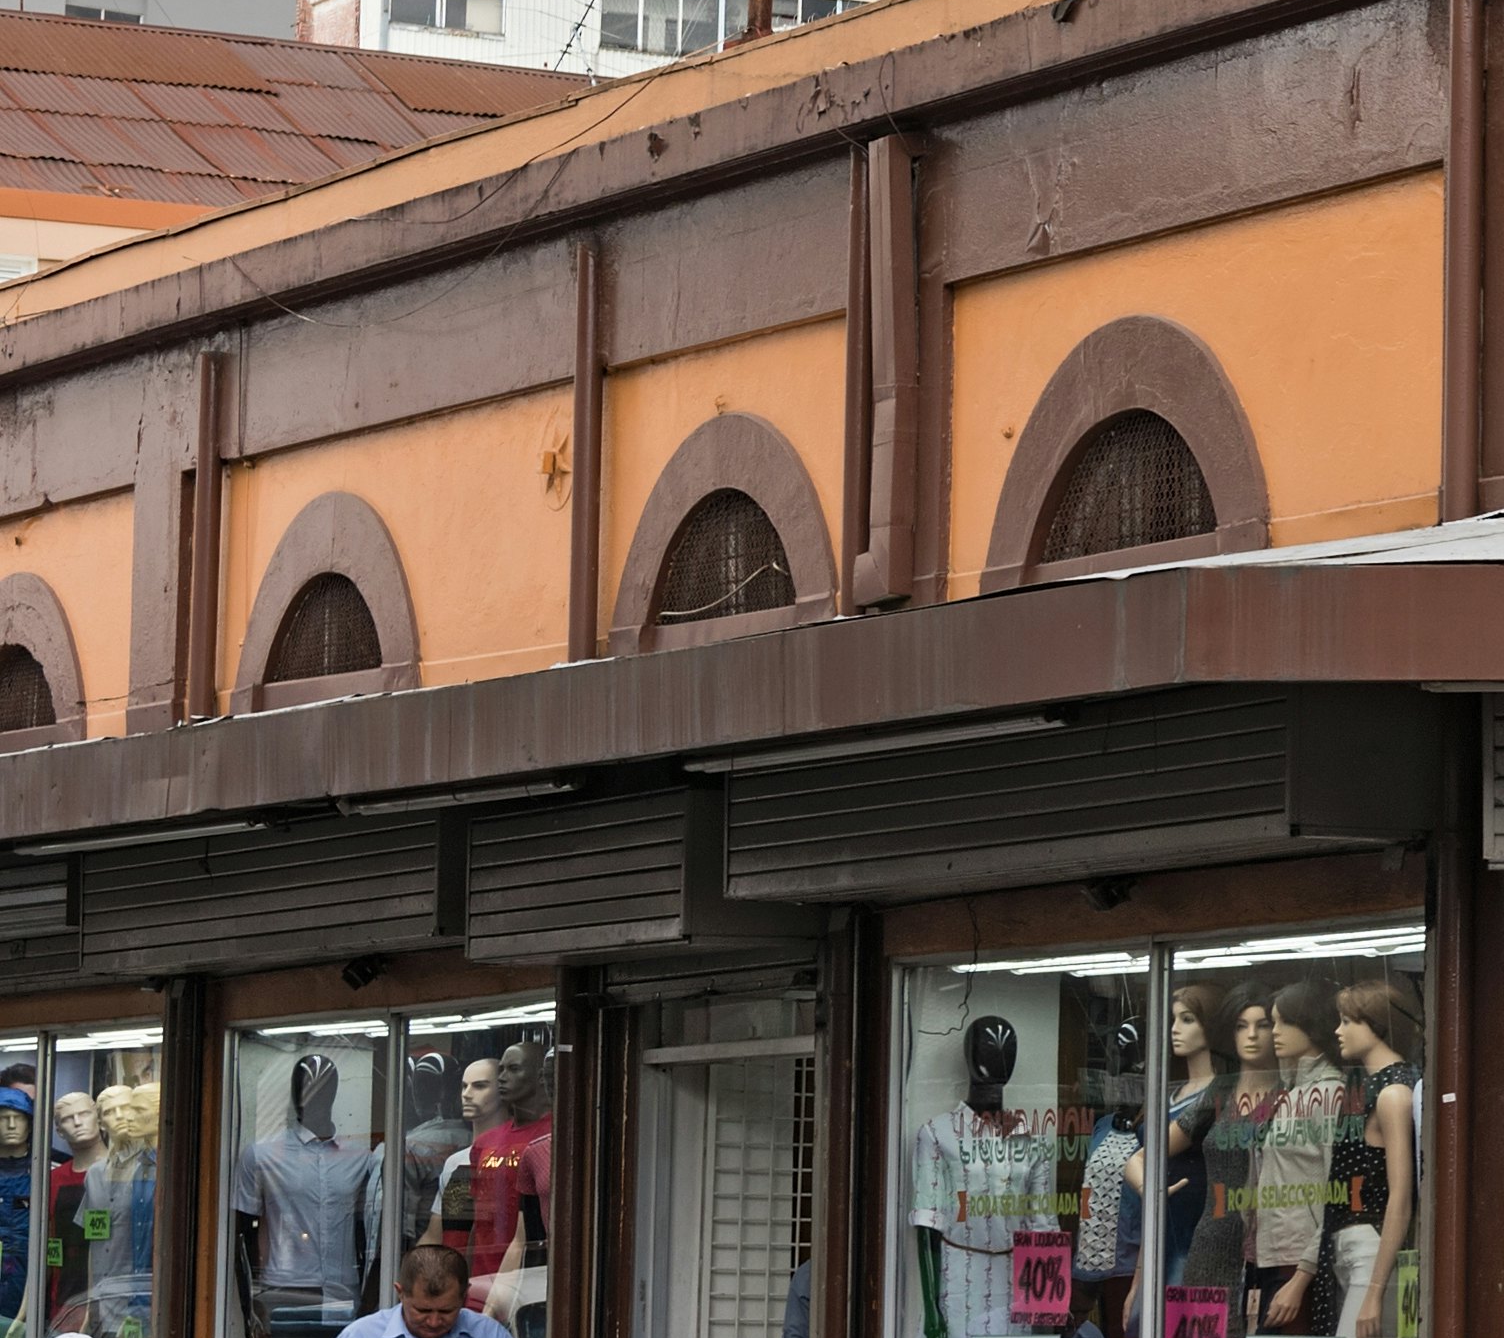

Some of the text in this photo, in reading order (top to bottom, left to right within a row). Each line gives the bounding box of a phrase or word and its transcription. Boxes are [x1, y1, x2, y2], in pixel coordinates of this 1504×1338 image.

[959, 1106, 1095, 1165] LIQUIDACION
[968, 1191, 1080, 1217] ROPA SELECCIONADA
[1261, 1178, 1350, 1209] SELECCIONADA
[1018, 1254, 1067, 1304] 40%
